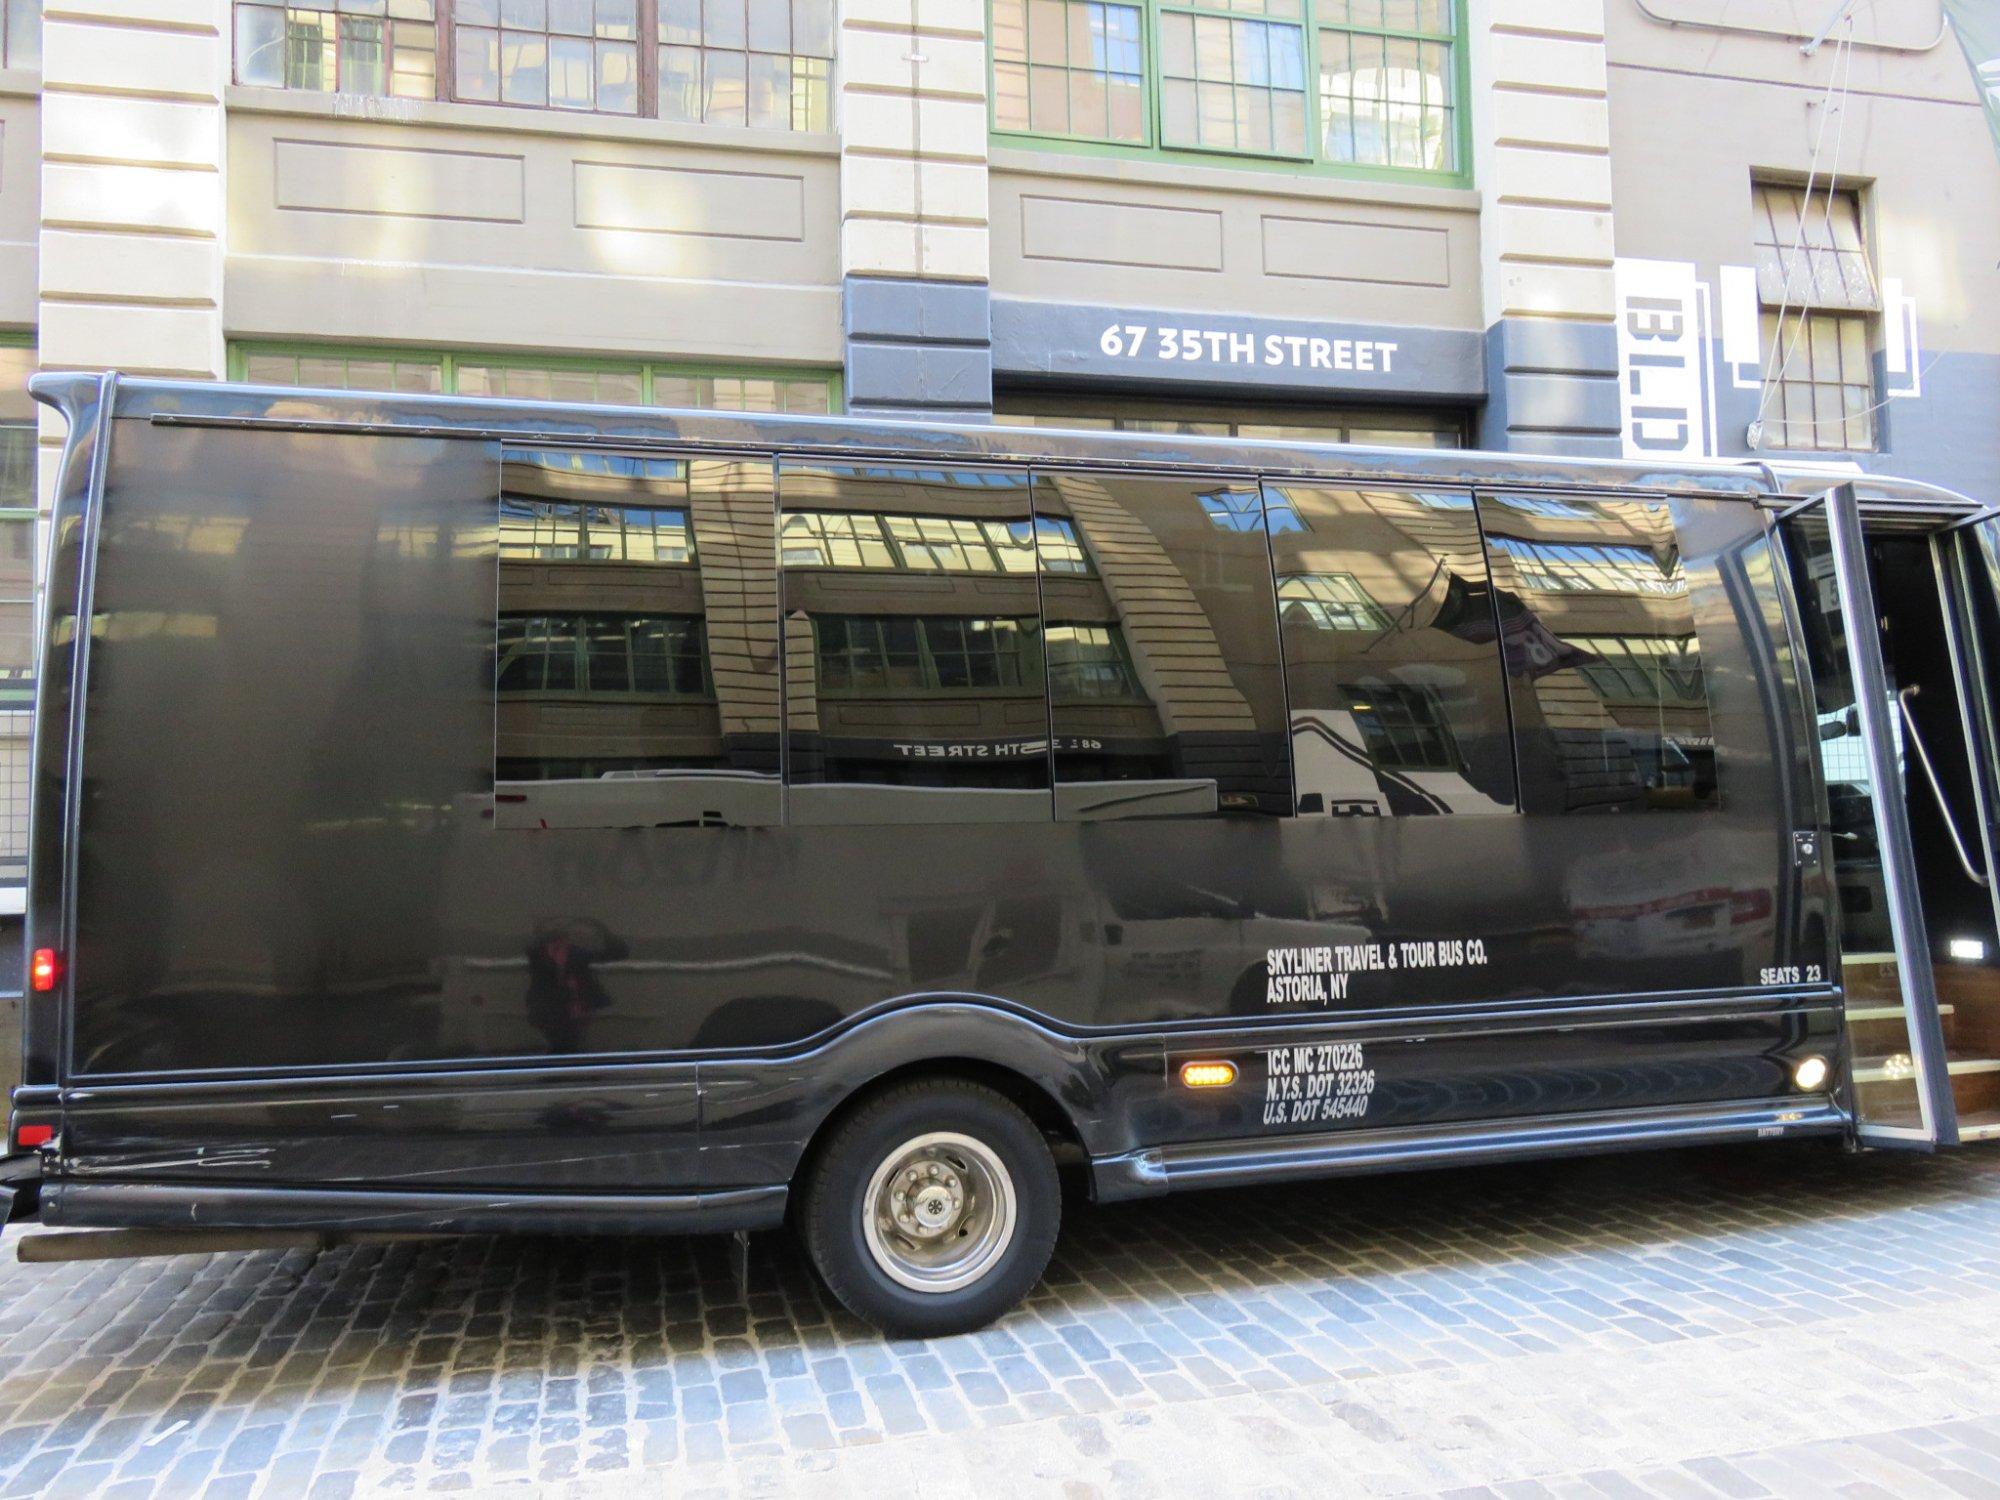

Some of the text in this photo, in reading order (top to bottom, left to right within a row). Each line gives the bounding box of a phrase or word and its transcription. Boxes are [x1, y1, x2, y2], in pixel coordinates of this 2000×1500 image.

[1100, 324, 1398, 372] 67 35TH STREET
[1626, 296, 1688, 450] BLD
[1266, 939, 1488, 976] SKYLINER TRAVEL & TOUR BUS CO.
[1266, 973, 1349, 1006] ASTORIA, NY
[1760, 965, 1821, 985] SEATS 23
[1267, 1043, 1363, 1076] ICC MC 270226
[1266, 1069, 1375, 1102] N.Y.S. DOT 32326
[1263, 1095, 1368, 1125] U.S. DOT 545440
